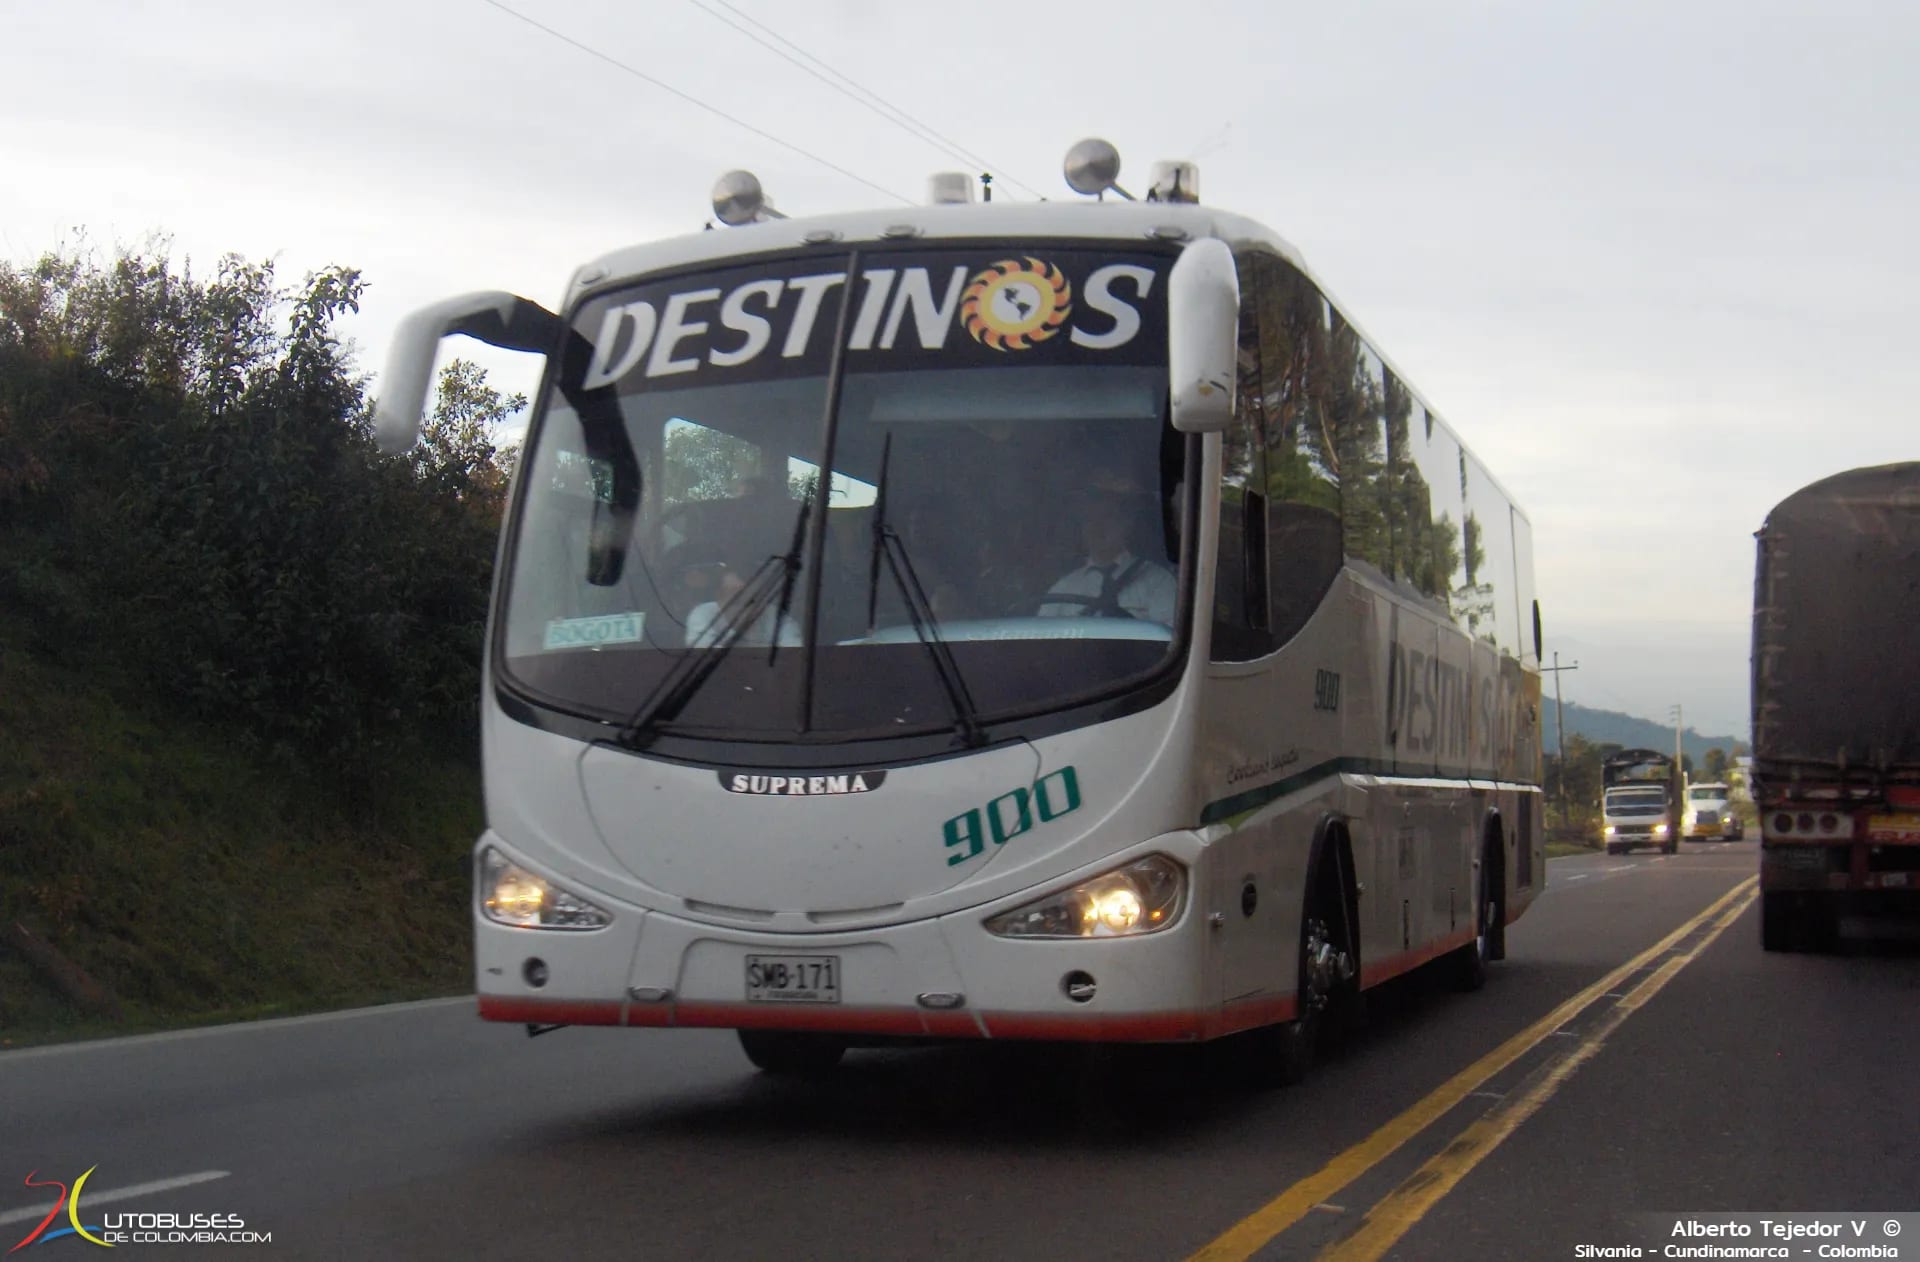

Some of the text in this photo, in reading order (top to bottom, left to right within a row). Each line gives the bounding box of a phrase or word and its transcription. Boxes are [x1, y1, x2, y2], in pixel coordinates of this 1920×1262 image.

[732, 774, 868, 795] SUPREMA
[943, 765, 1082, 867] 900
[748, 962, 836, 990] SWB-171
